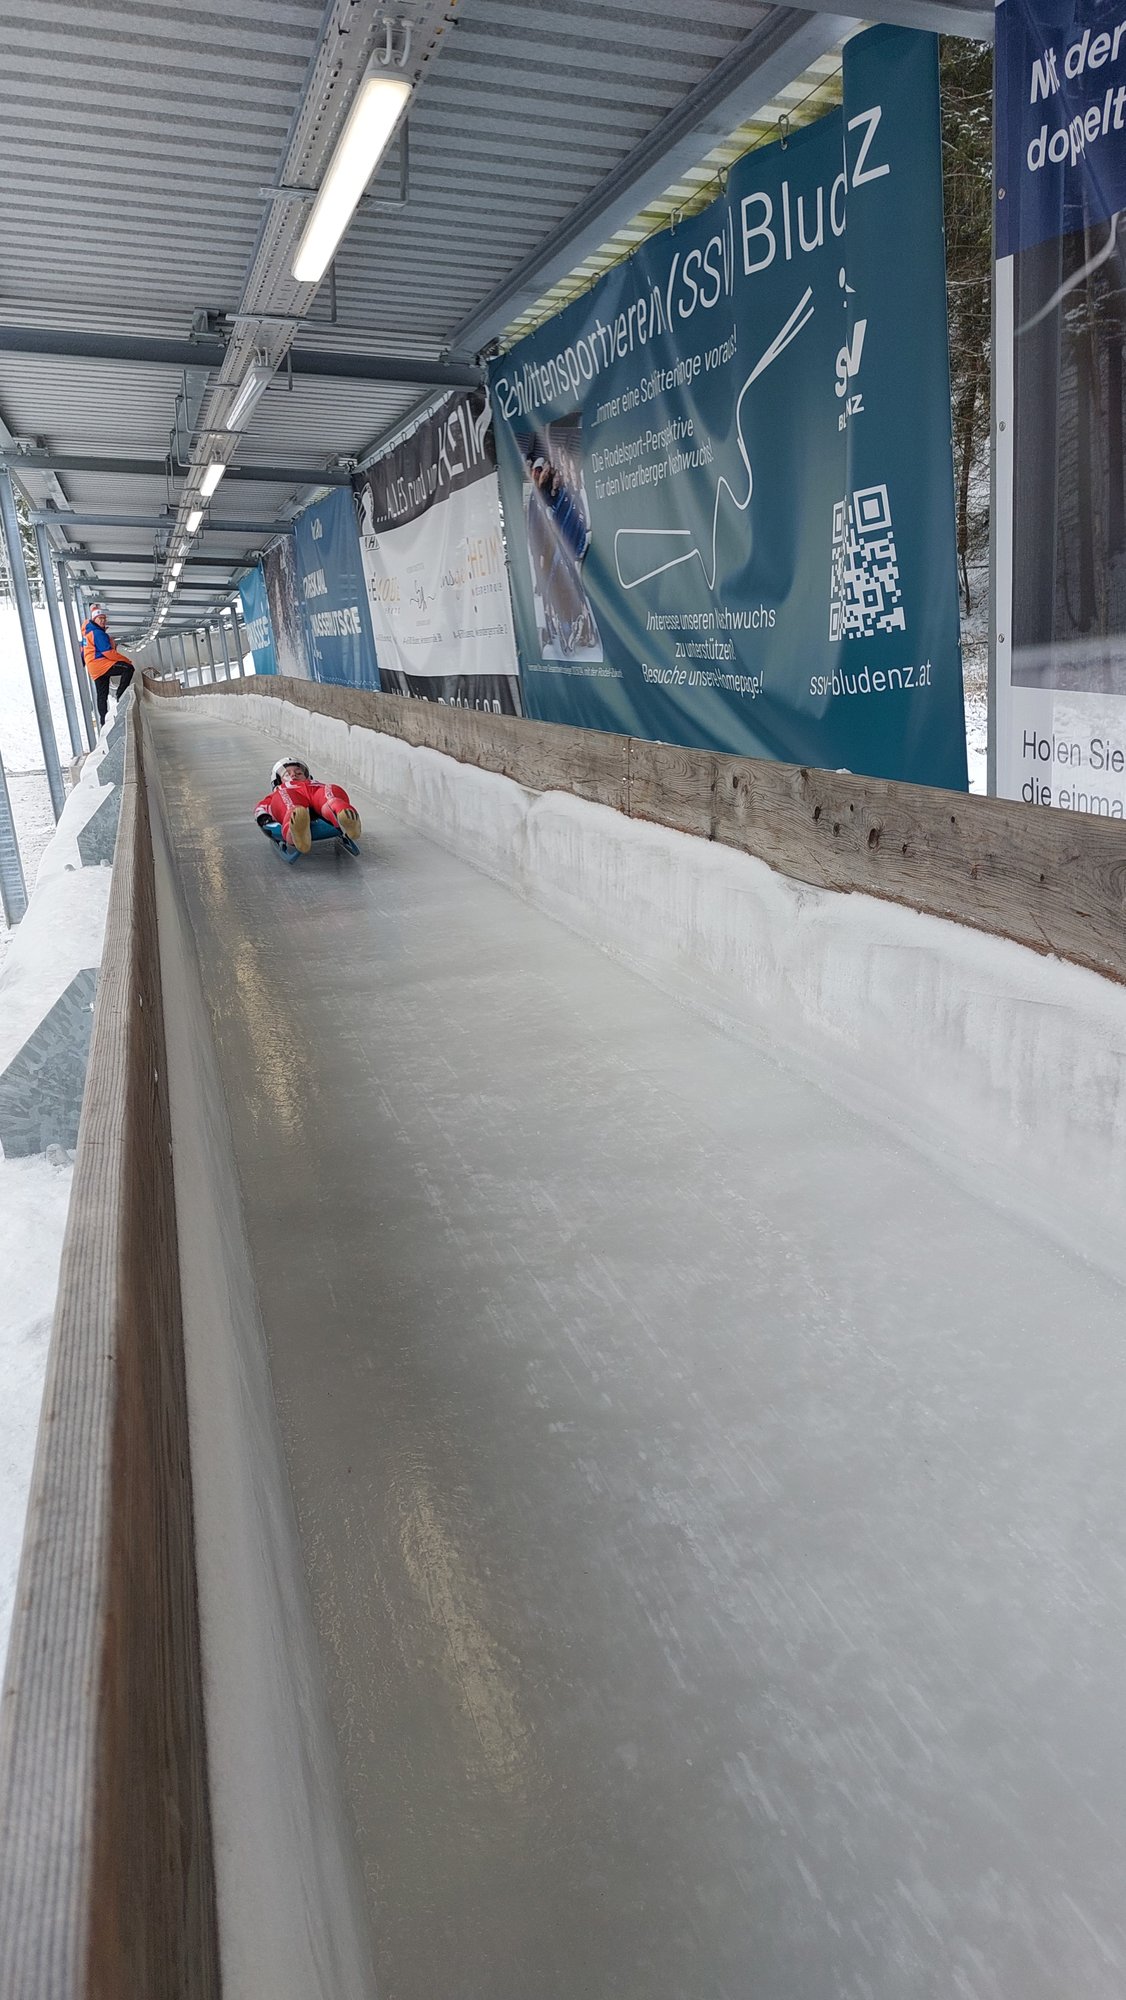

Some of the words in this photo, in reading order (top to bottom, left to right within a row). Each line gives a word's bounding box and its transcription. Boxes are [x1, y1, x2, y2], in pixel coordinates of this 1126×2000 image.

[1030, 48, 1060, 104] Mt
[1065, 20, 1126, 79] der
[622, 387, 640, 413] eine
[704, 323, 737, 372] voraus!
[591, 452, 604, 474] Die
[606, 477, 620, 497] den
[619, 460, 668, 491] Vorarlberger
[646, 611, 680, 631] Interesse
[680, 612, 714, 630] unseren
[675, 642, 686, 658] zu
[641, 663, 687, 684] Besuche
[688, 670, 717, 687] unsere
[715, 668, 764, 699] Homepage!
[809, 659, 932, 696] ssv-bludenz.at
[1022, 729, 1081, 767] Holen
[1089, 738, 1125, 773] Sie
[1021, 776, 1052, 806] die
